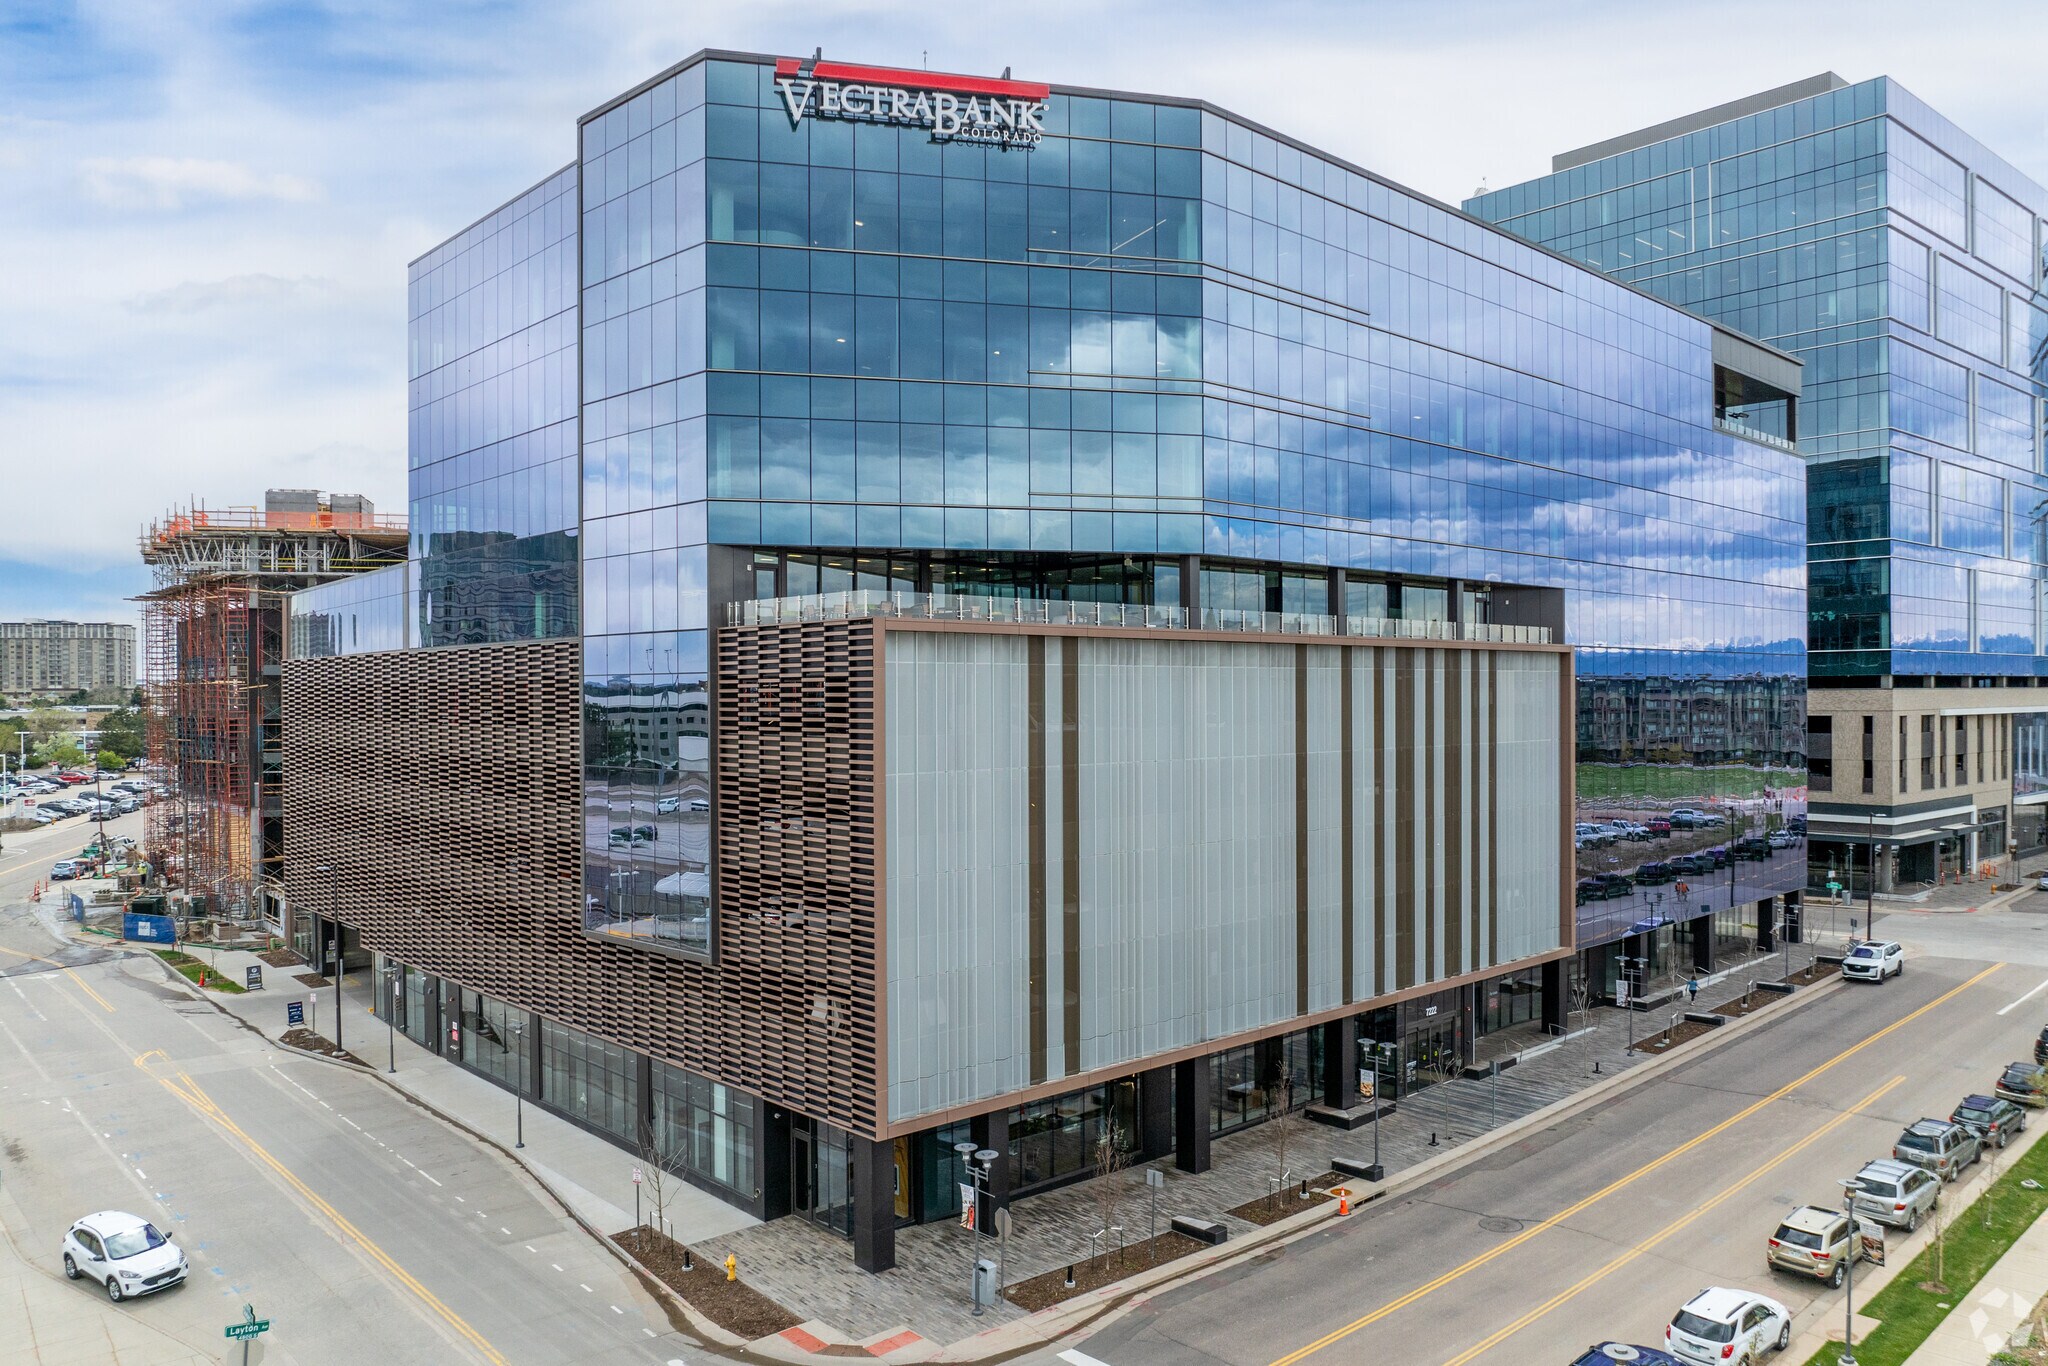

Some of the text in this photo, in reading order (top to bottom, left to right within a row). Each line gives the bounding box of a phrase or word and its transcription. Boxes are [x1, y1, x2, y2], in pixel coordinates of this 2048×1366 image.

[961, 126, 1042, 144] COLORADO
[1426, 1006, 1438, 1016] 7222
[230, 1325, 258, 1335] Layton
